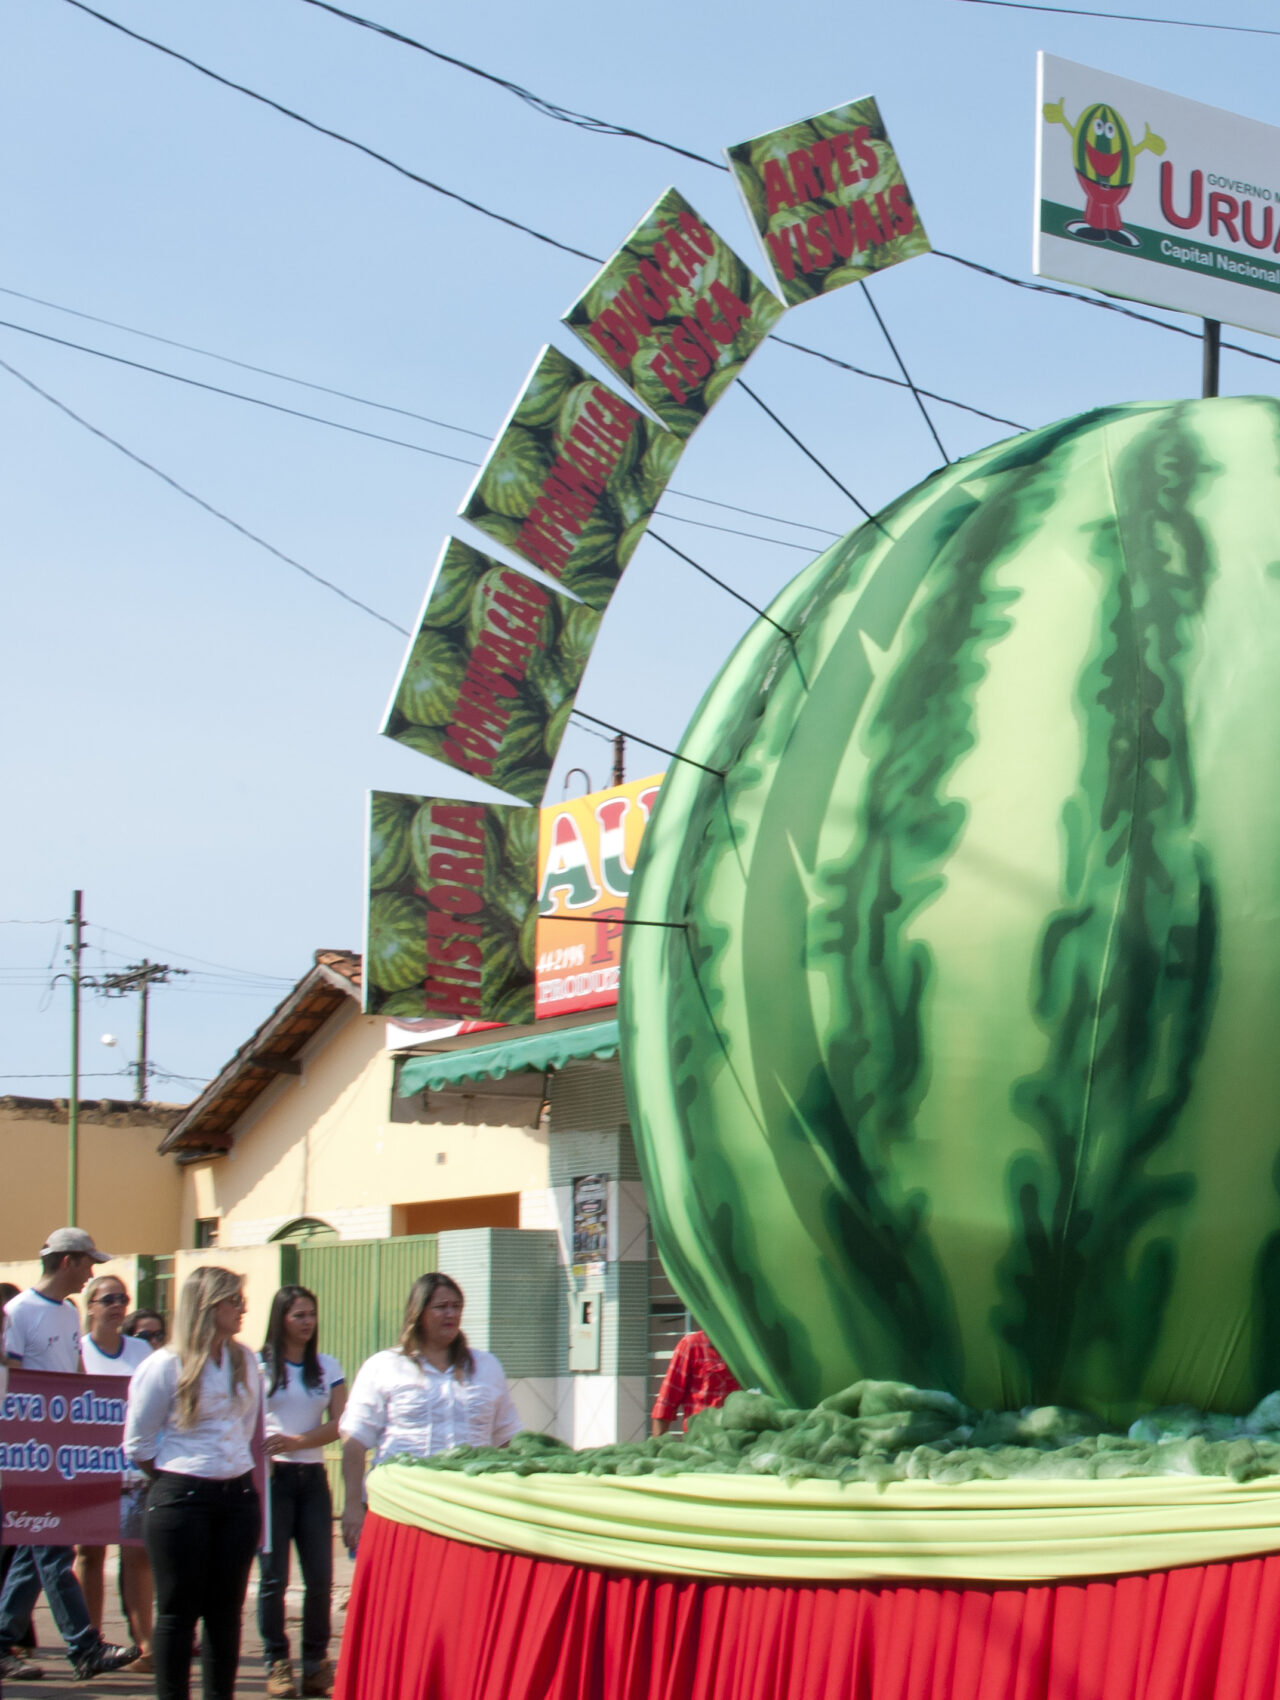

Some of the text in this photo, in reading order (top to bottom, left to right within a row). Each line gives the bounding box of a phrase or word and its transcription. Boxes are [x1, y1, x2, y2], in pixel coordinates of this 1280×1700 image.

[764, 125, 879, 215] ARTES
[1207, 173, 1271, 200] GOVERNO
[766, 184, 915, 282] VISUAIS
[1160, 240, 1214, 267] Capital
[1216, 253, 1280, 284] Nacional
[588, 211, 716, 370] EDUCAÇÃO
[648, 278, 752, 405] FÍSICA
[515, 385, 640, 578] INFORMÁTICA
[441, 572, 551, 777] COMPUTAÇÃO
[415, 805, 486, 1017] HISTÓRIA
[0, 1390, 127, 1425] eva o alun
[3, 1510, 61, 1533] Sérgio
